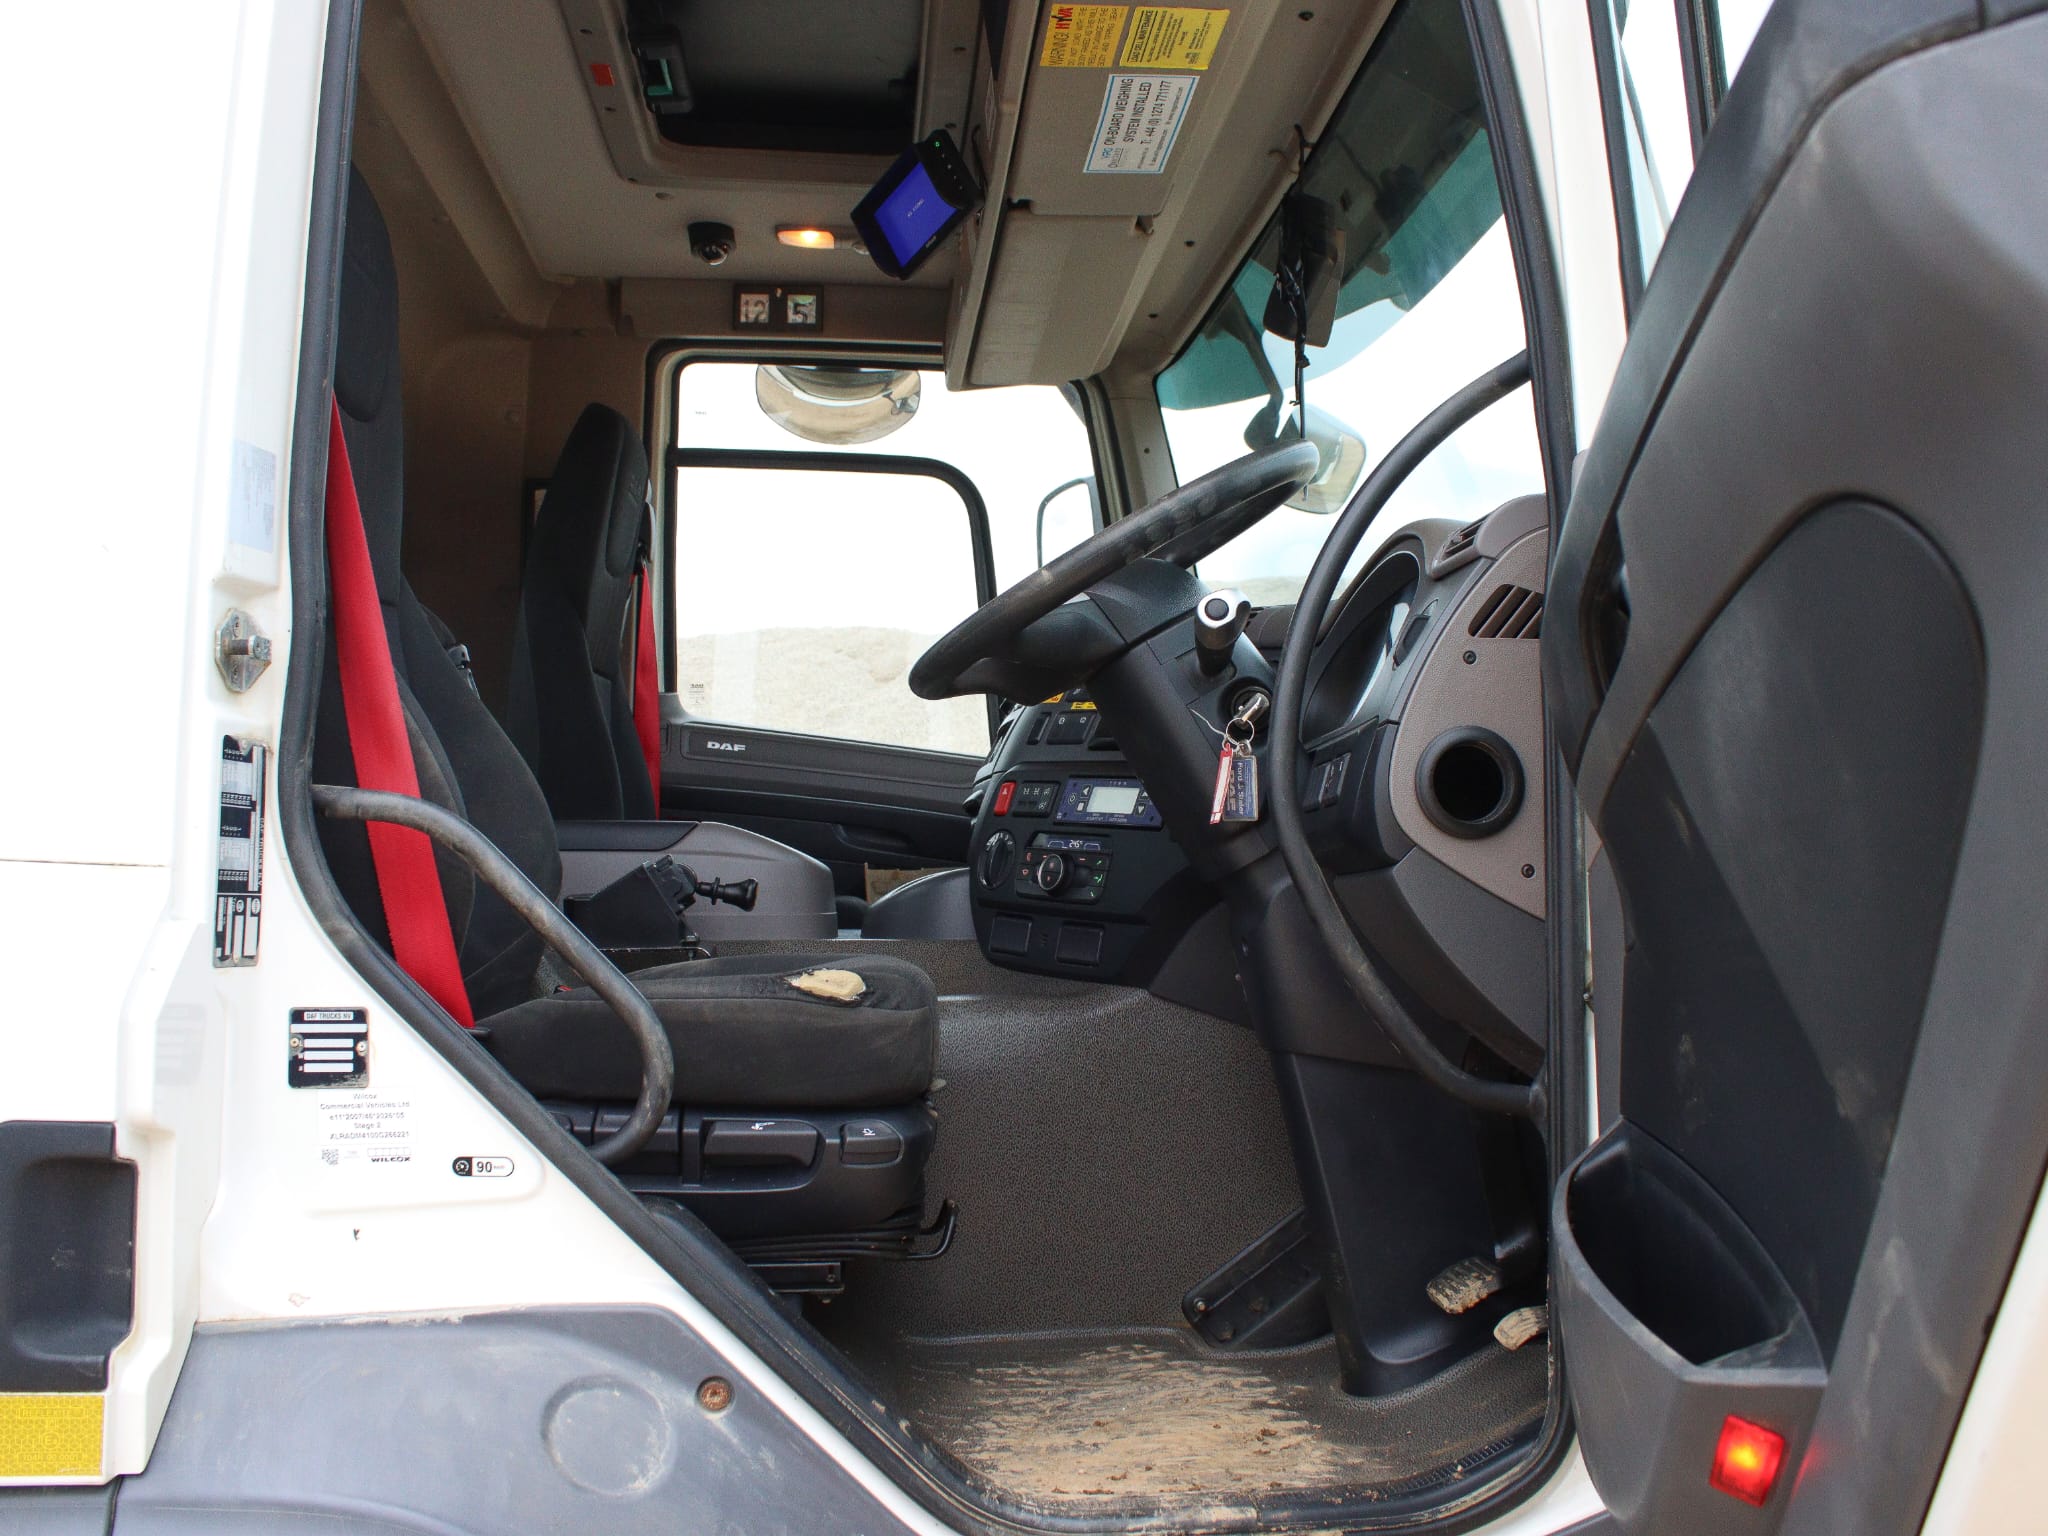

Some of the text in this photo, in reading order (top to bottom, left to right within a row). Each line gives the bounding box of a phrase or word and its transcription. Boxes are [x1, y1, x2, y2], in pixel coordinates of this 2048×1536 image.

[1051, 7, 1073, 29] HYVA
[1156, 80, 1172, 101] 771177
[1104, 113, 1124, 145] ON-BOARD
[1114, 78, 1134, 111] WEIGHING
[1123, 82, 1152, 142] SYSTEM INSTALLED
[1152, 104, 1164, 116] 1274
[706, 740, 745, 751] DAF
[320, 1102, 363, 1110] Commercial
[476, 1161, 492, 1173] 90
